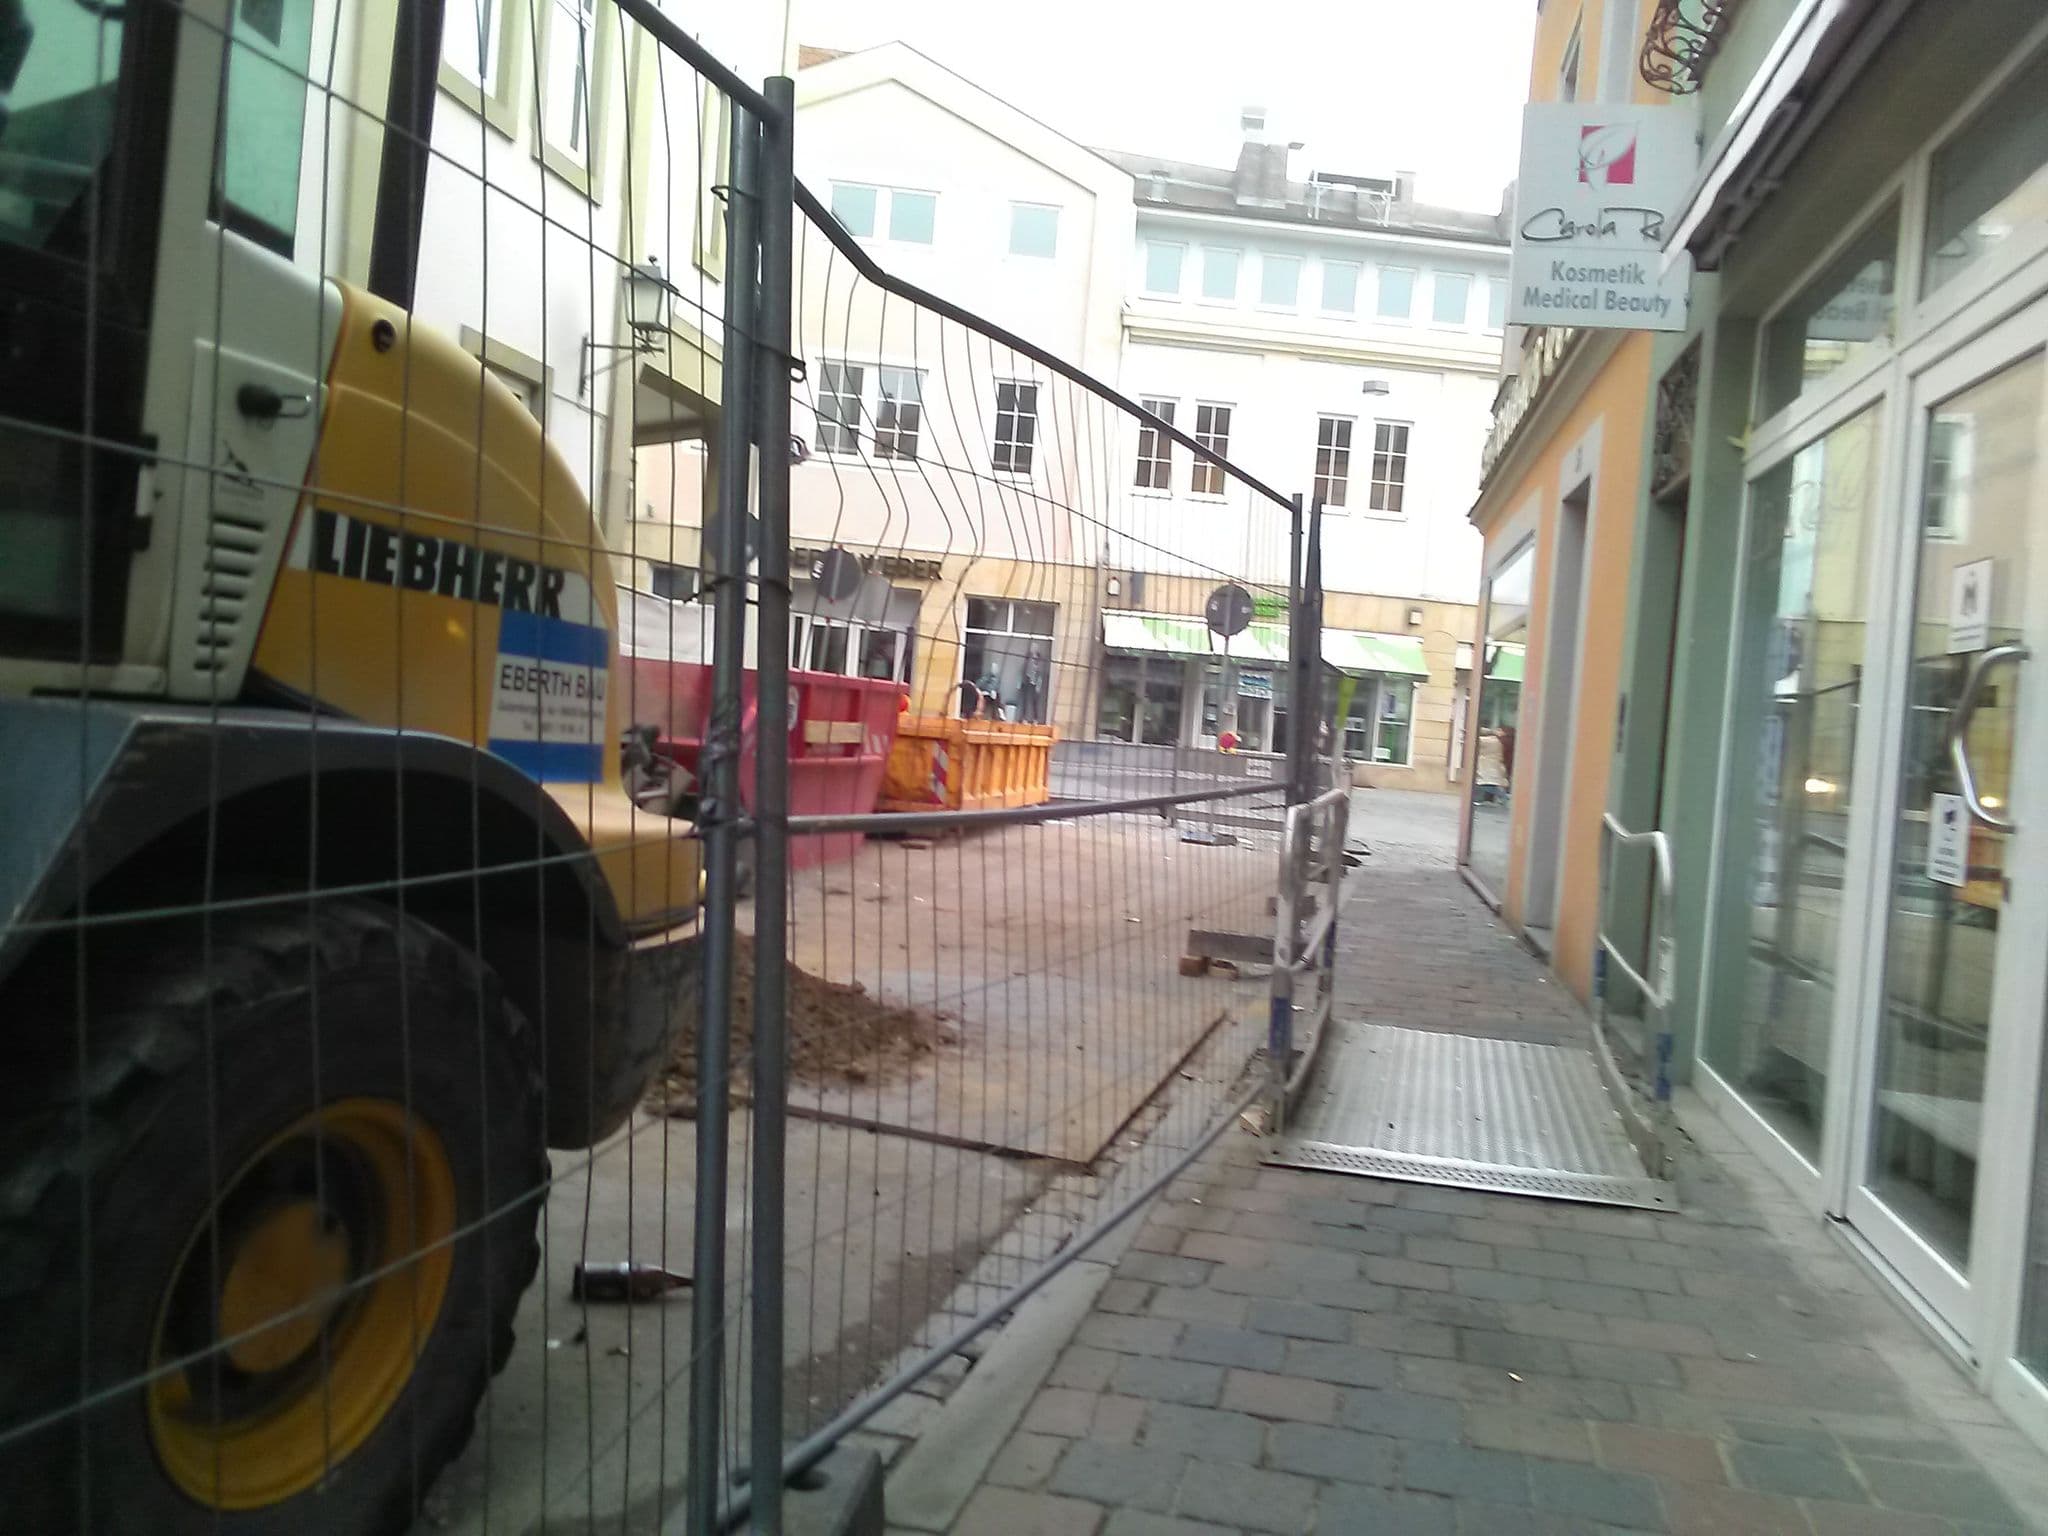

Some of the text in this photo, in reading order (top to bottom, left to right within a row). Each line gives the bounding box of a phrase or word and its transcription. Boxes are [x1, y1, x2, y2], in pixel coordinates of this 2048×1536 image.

[1521, 207, 1617, 242] Carola
[1551, 260, 1645, 285] Kosmetik
[1523, 286, 1671, 318] Medical Beauty
[311, 509, 566, 621] LIEBHERR
[501, 664, 572, 697] EBERTH
